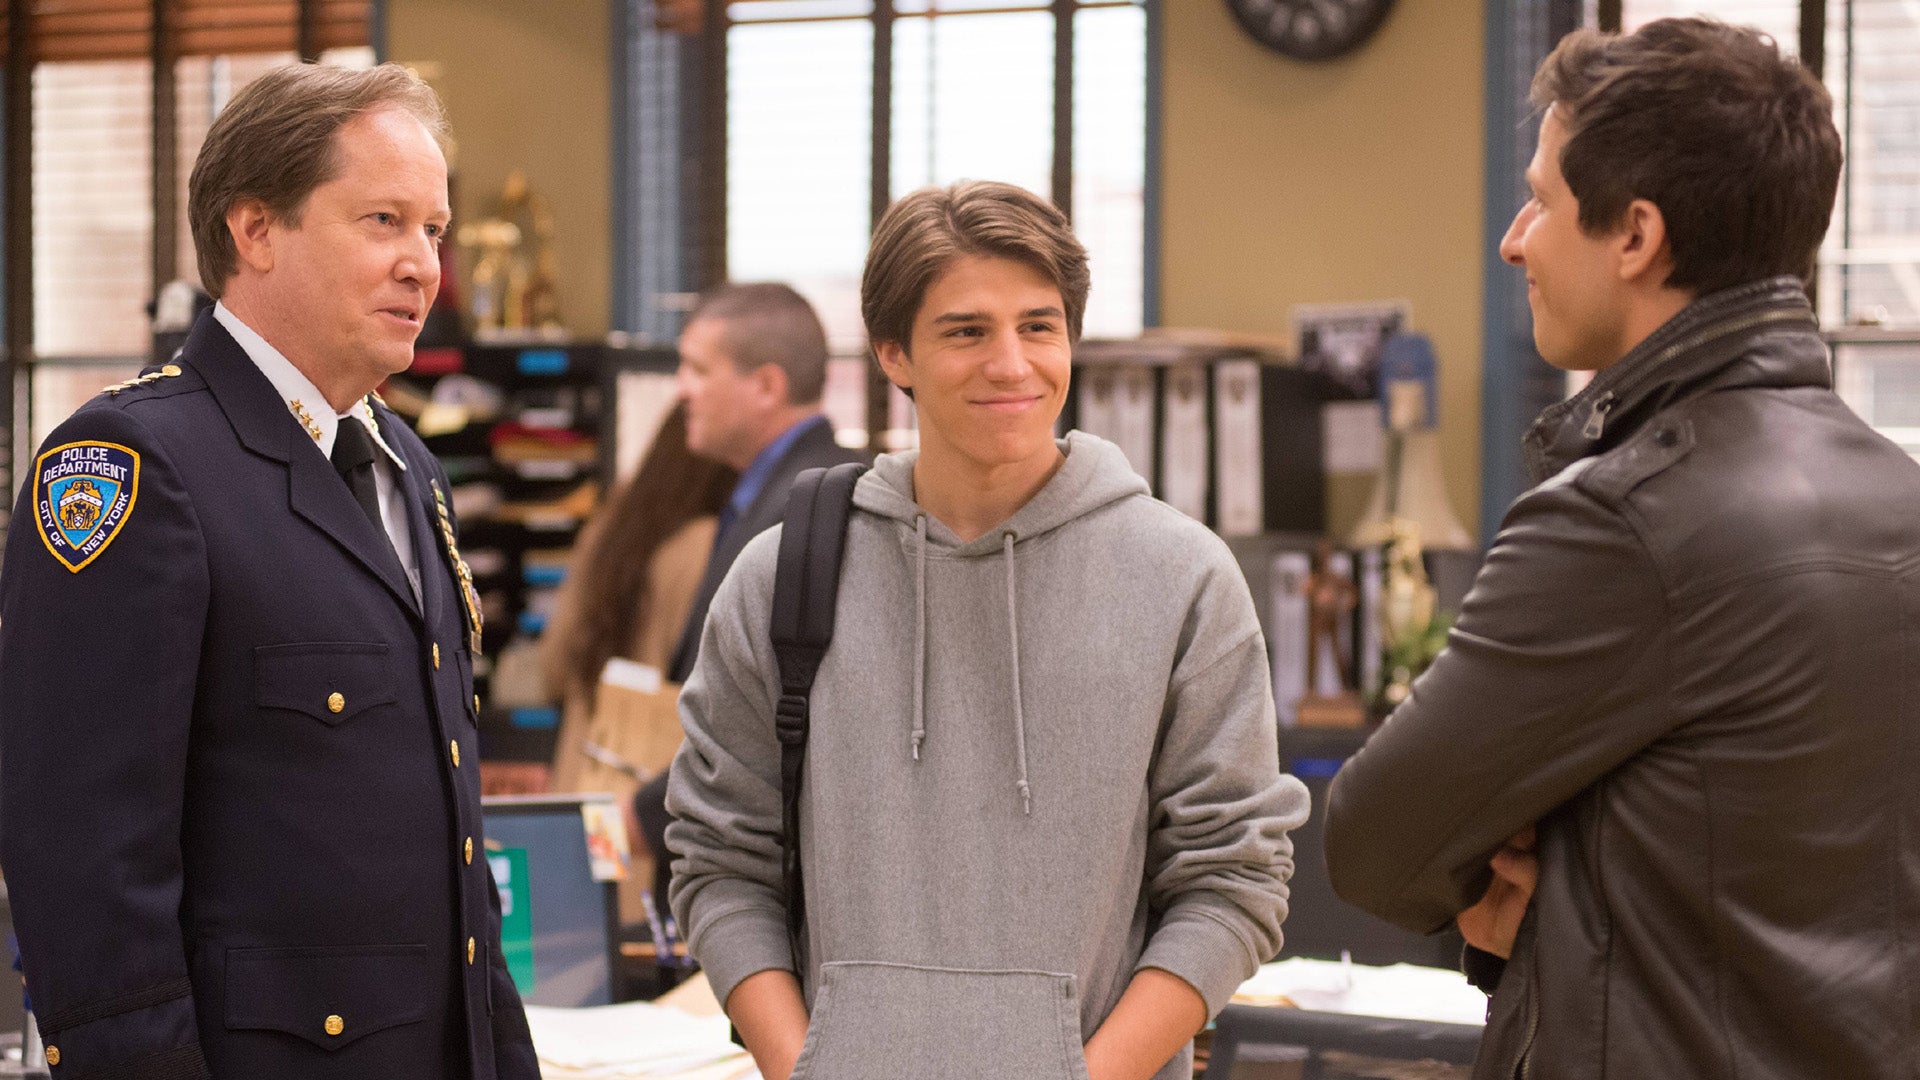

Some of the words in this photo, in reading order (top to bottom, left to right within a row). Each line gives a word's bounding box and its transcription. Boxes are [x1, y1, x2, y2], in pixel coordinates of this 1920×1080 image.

[61, 447, 108, 462] POLICE
[43, 461, 127, 484] DEPARTMENT
[40, 500, 54, 528] CITY
[50, 531, 66, 547] OF
[81, 529, 106, 555] NEW
[104, 492, 129, 526] YORK
